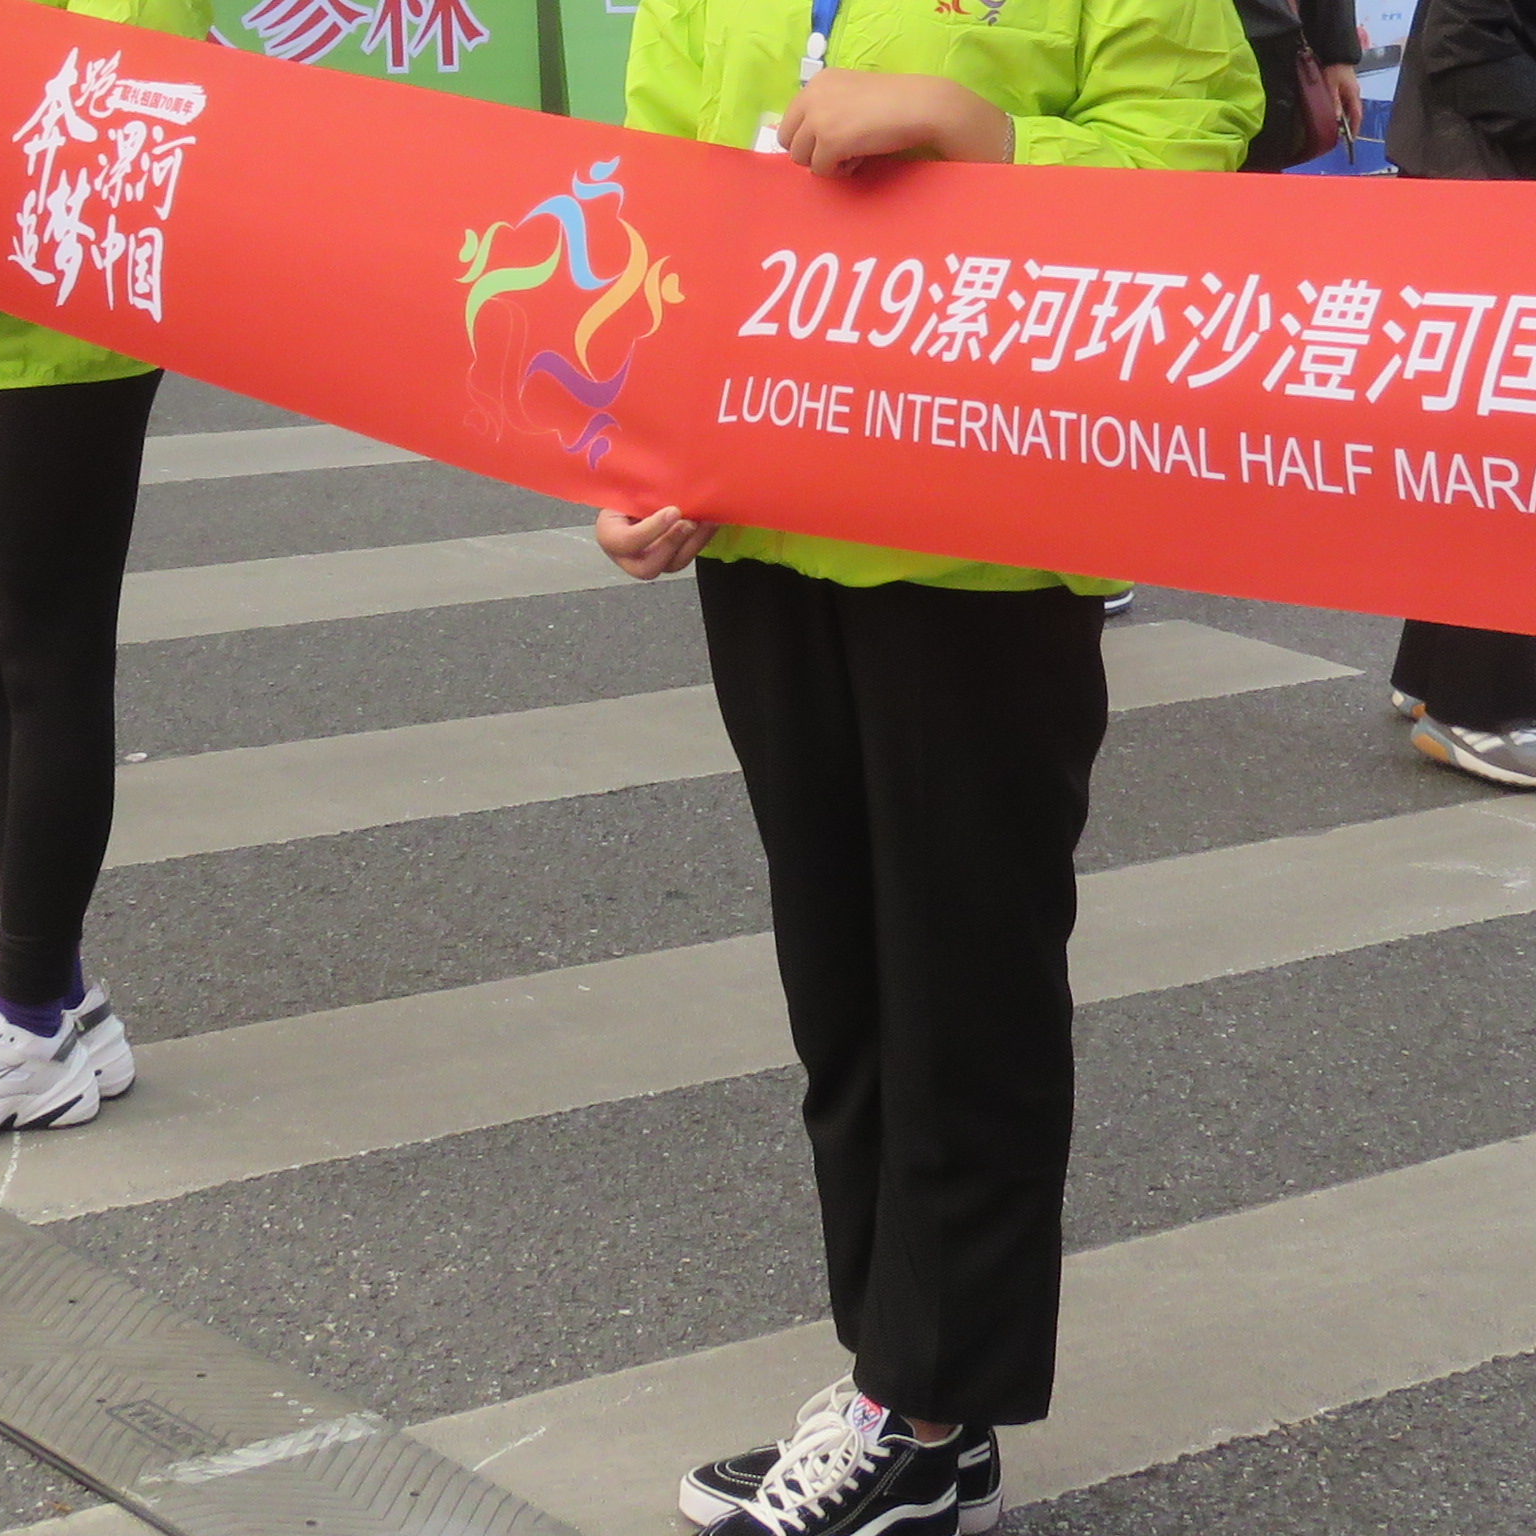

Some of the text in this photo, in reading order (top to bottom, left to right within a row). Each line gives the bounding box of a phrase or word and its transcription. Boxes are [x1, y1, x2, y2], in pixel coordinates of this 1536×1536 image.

[717, 376, 855, 434] LUOHE
[864, 389, 1226, 481] INTERNATIONAL
[1239, 432, 1374, 495] HALF
